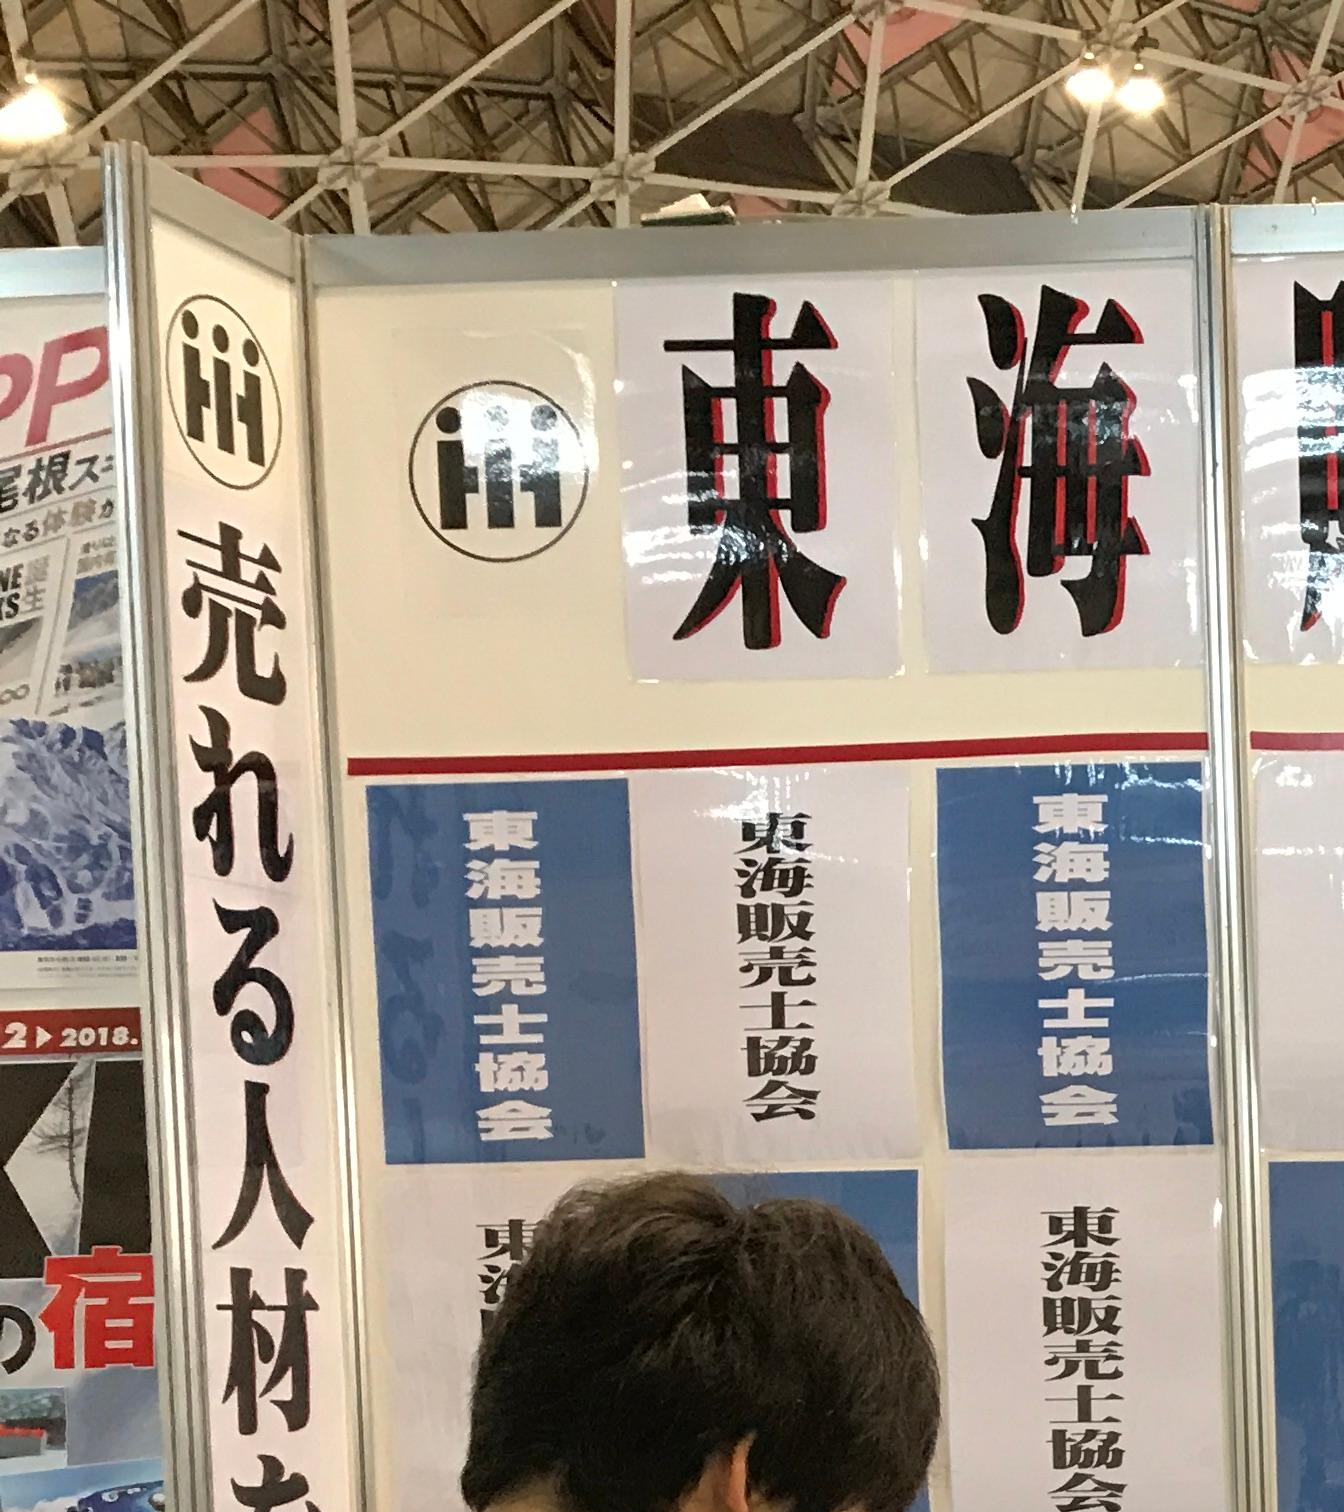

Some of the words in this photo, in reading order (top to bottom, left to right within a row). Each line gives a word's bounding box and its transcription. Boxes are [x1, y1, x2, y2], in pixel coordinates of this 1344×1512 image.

[463, 811, 554, 1141] 東海販売士協会
[732, 810, 822, 1124] 東海販売士協会
[1032, 793, 1122, 1128] 東海販売士協会
